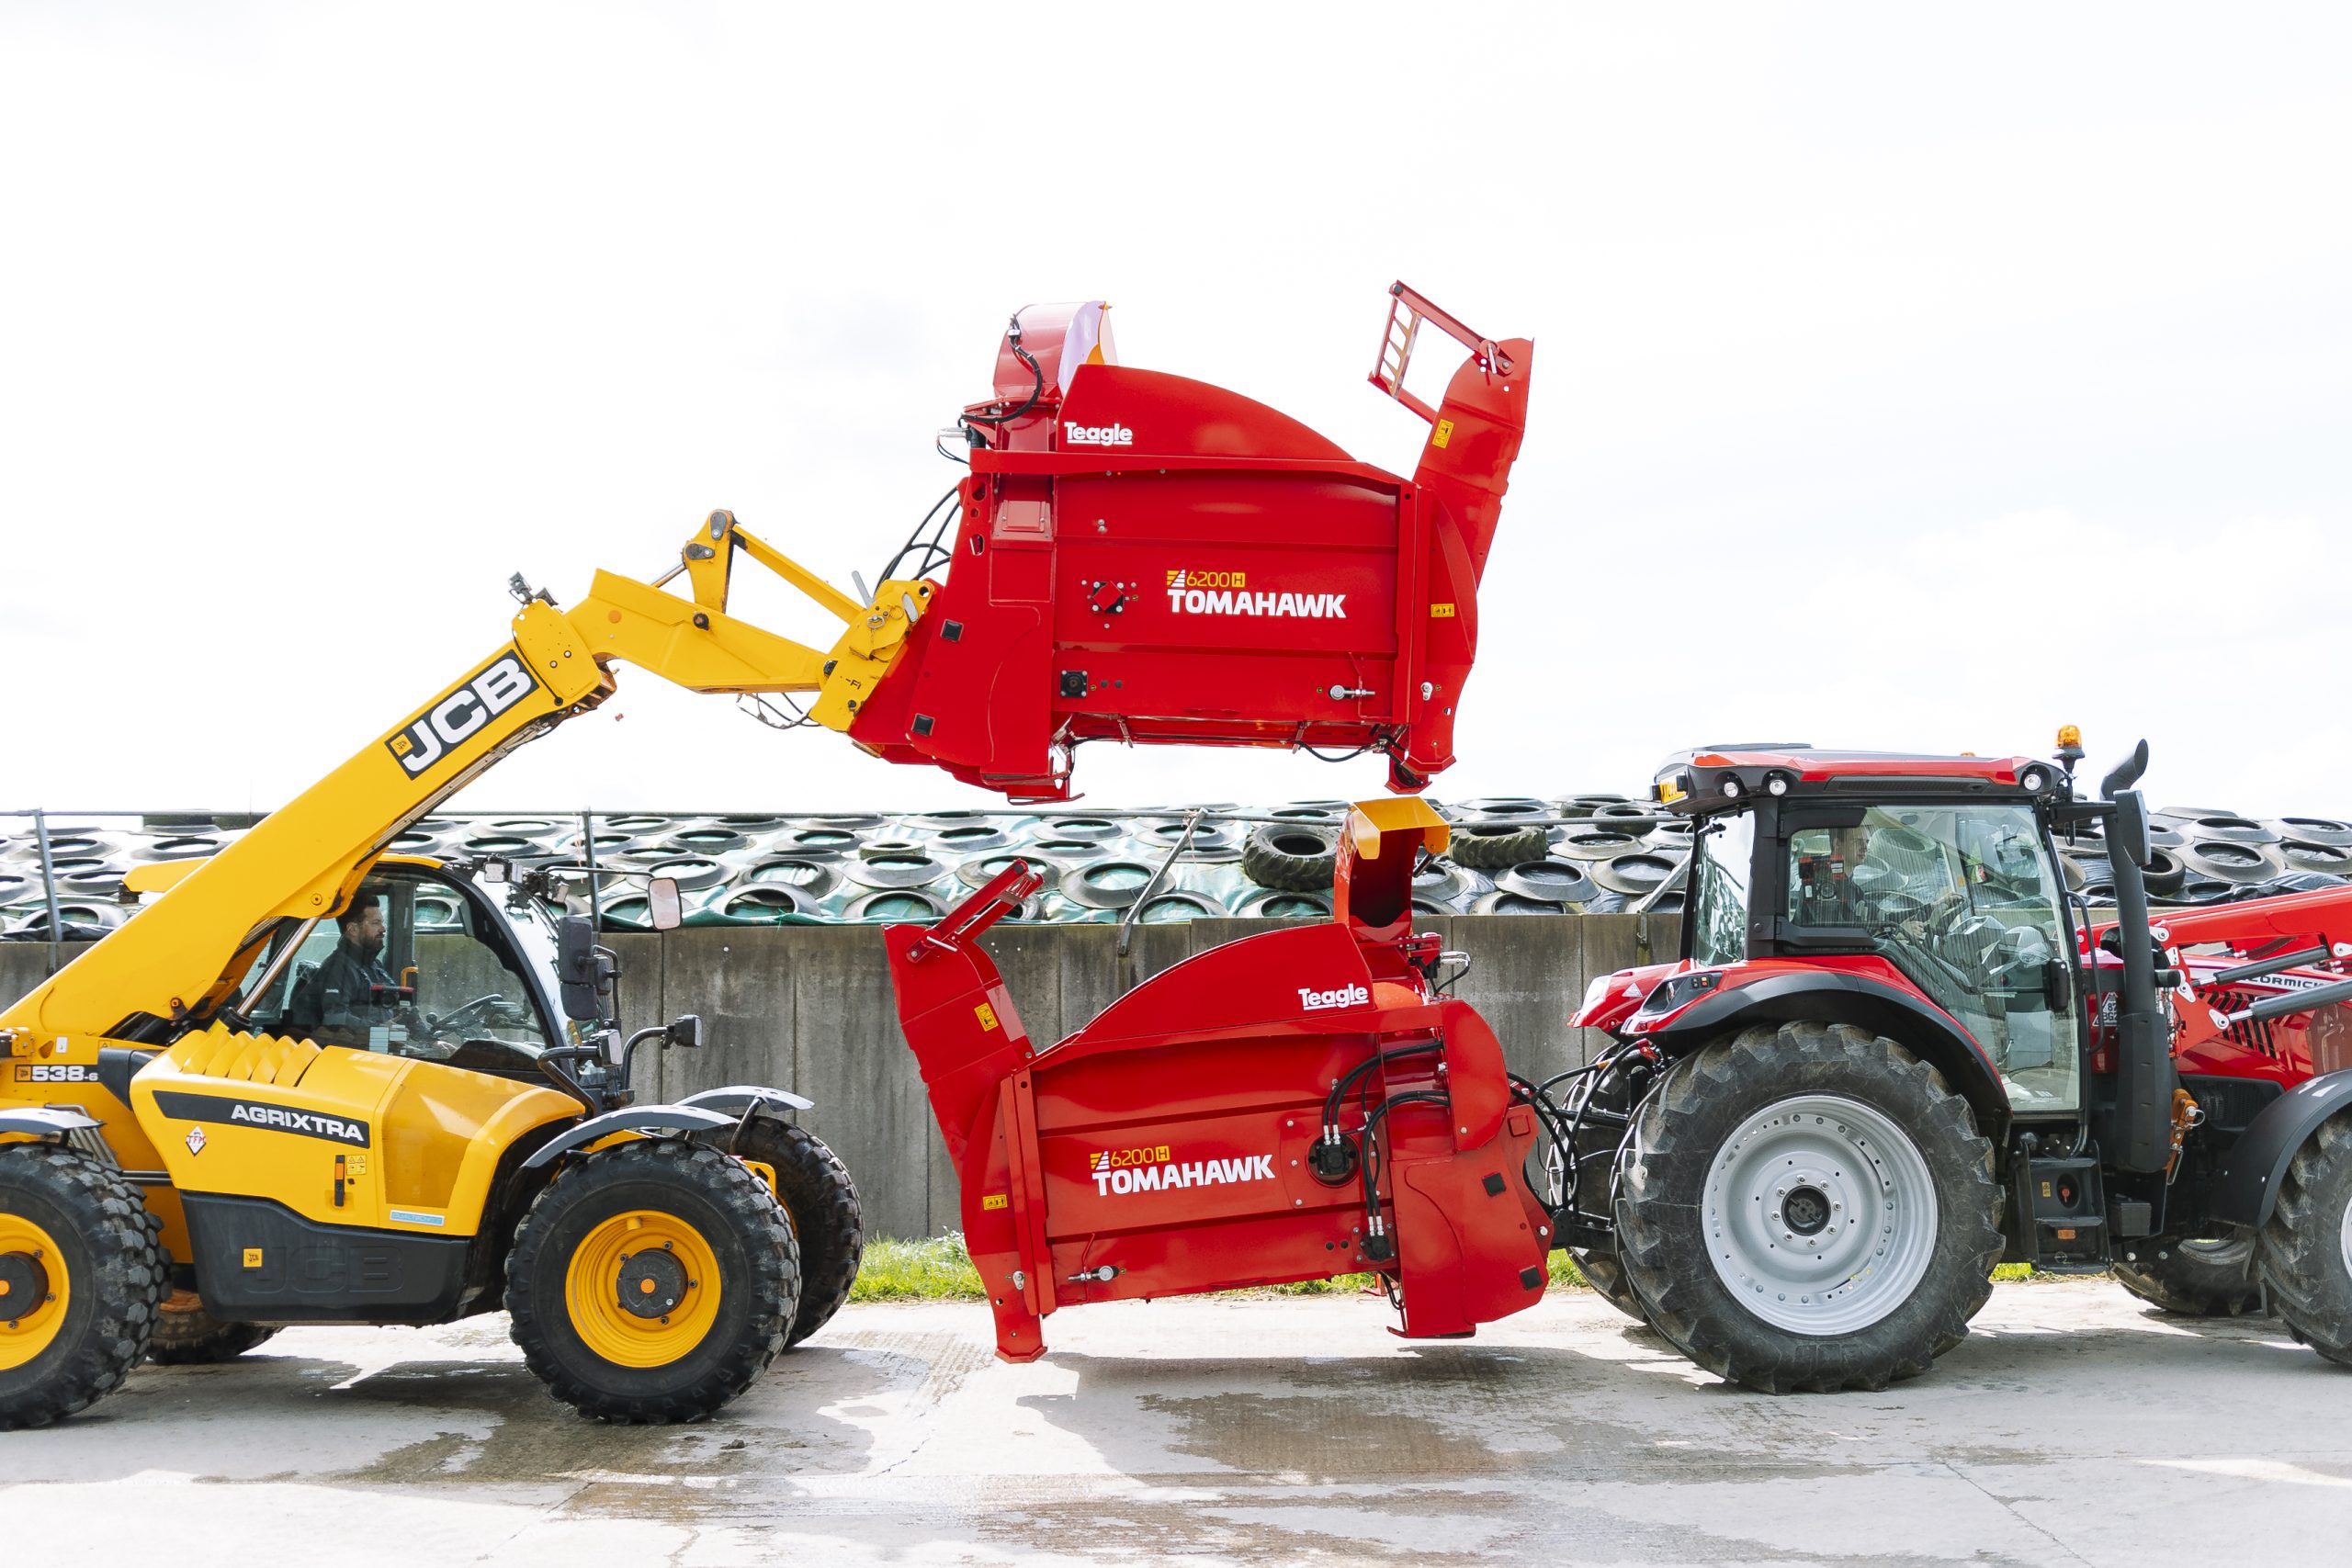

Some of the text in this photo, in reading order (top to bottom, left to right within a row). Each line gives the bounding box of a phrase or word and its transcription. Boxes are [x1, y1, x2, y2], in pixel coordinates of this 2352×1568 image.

[1064, 422, 1133, 446] Teagle
[1186, 570, 1229, 588] 6200
[1167, 589, 1347, 618] TOMAHAWK
[401, 658, 532, 772] JCB
[1297, 983, 1369, 1009] Teagle
[31, 1066, 98, 1082] 538-6
[231, 1104, 365, 1142] AGRIXTRA
[1111, 1147, 1155, 1168] 6200
[1091, 1154, 1276, 1197] TOMAHAWK
